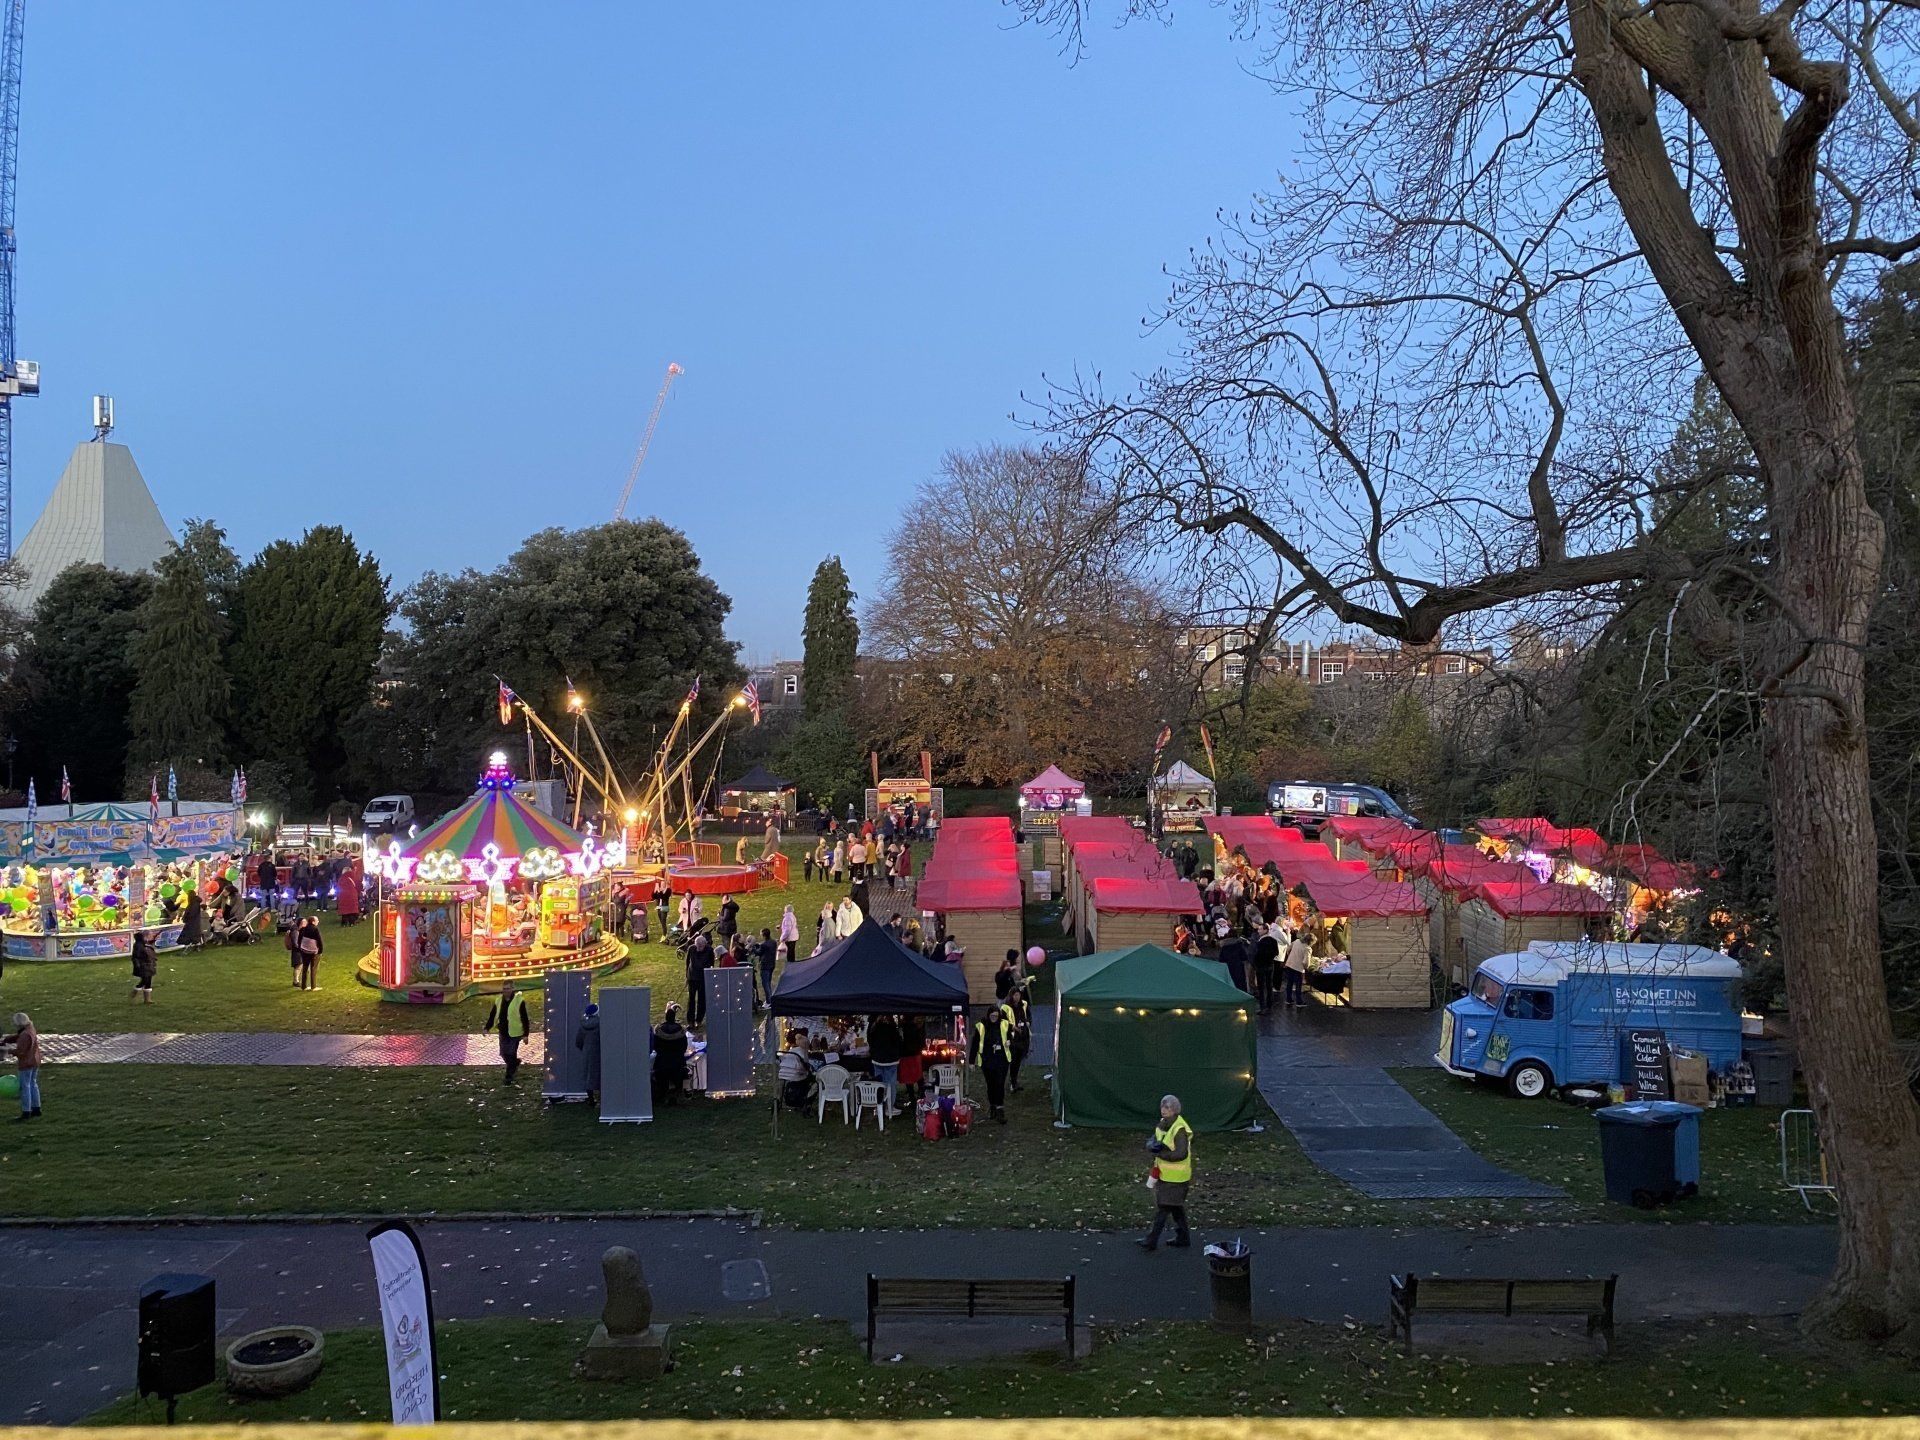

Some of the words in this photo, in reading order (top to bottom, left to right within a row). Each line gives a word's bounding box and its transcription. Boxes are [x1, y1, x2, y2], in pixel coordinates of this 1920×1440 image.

[56, 826, 89, 840] Family
[90, 824, 109, 837] fun
[109, 823, 124, 837] for
[1615, 987, 1671, 1000] BANQUET
[1674, 989, 1696, 1000] INN
[1634, 1043, 1662, 1055] Mulled
[1636, 1053, 1658, 1062] Cider
[1638, 1070, 1664, 1081] Mulled
[1638, 1080, 1658, 1090] Wine
